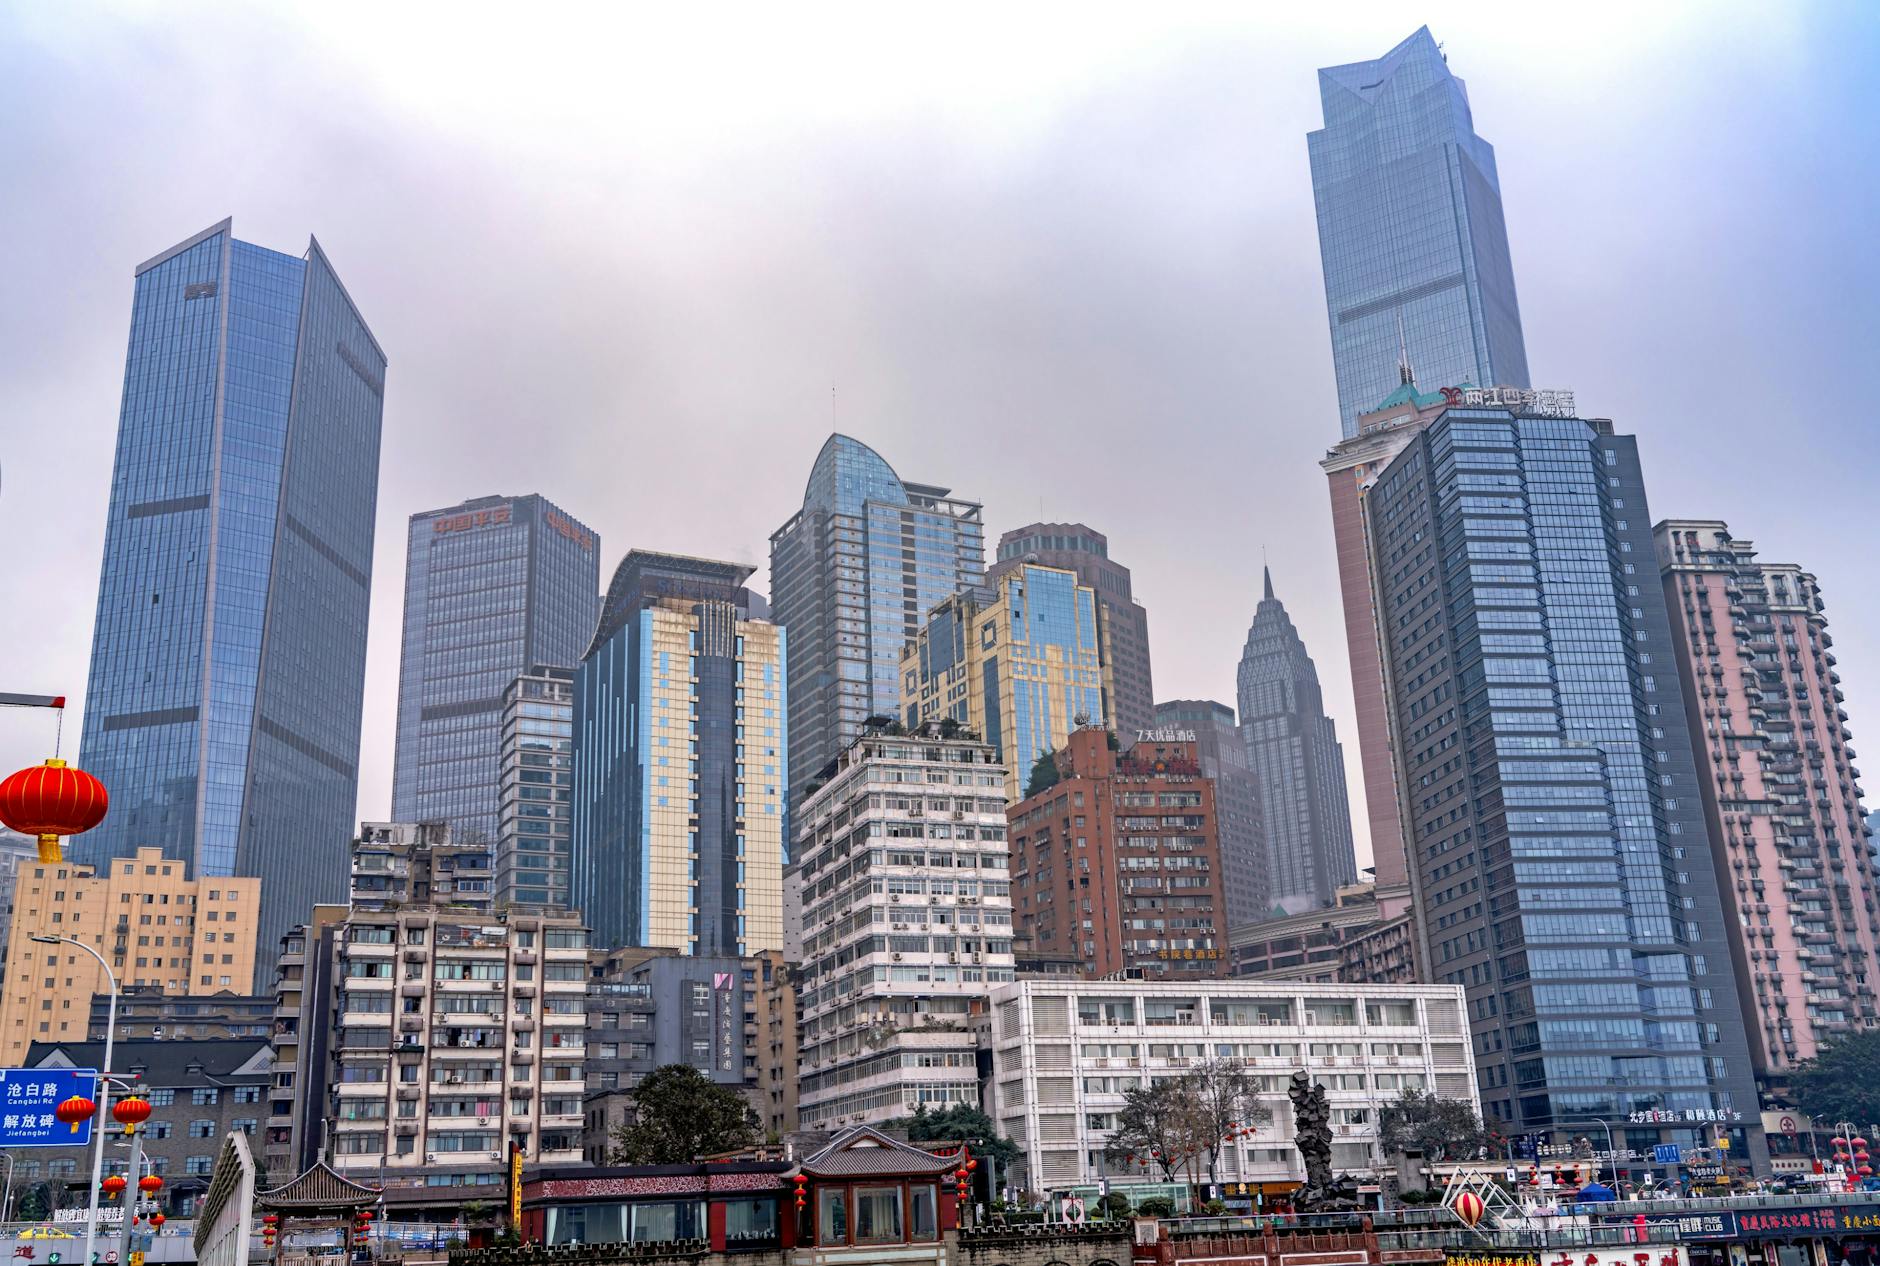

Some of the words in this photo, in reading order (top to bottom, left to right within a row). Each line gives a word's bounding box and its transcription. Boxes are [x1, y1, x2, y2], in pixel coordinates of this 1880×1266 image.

[432, 508, 511, 534] 中国平安
[1136, 729, 1196, 742] 7天优品酒店
[7, 1082, 57, 1097] 沧白路
[8, 1098, 40, 1106] Cangbai
[3, 1114, 54, 1128] 解放碑
[1703, 1216, 1721, 1224] MUSIC
[1705, 1223, 1723, 1232] CLUB
